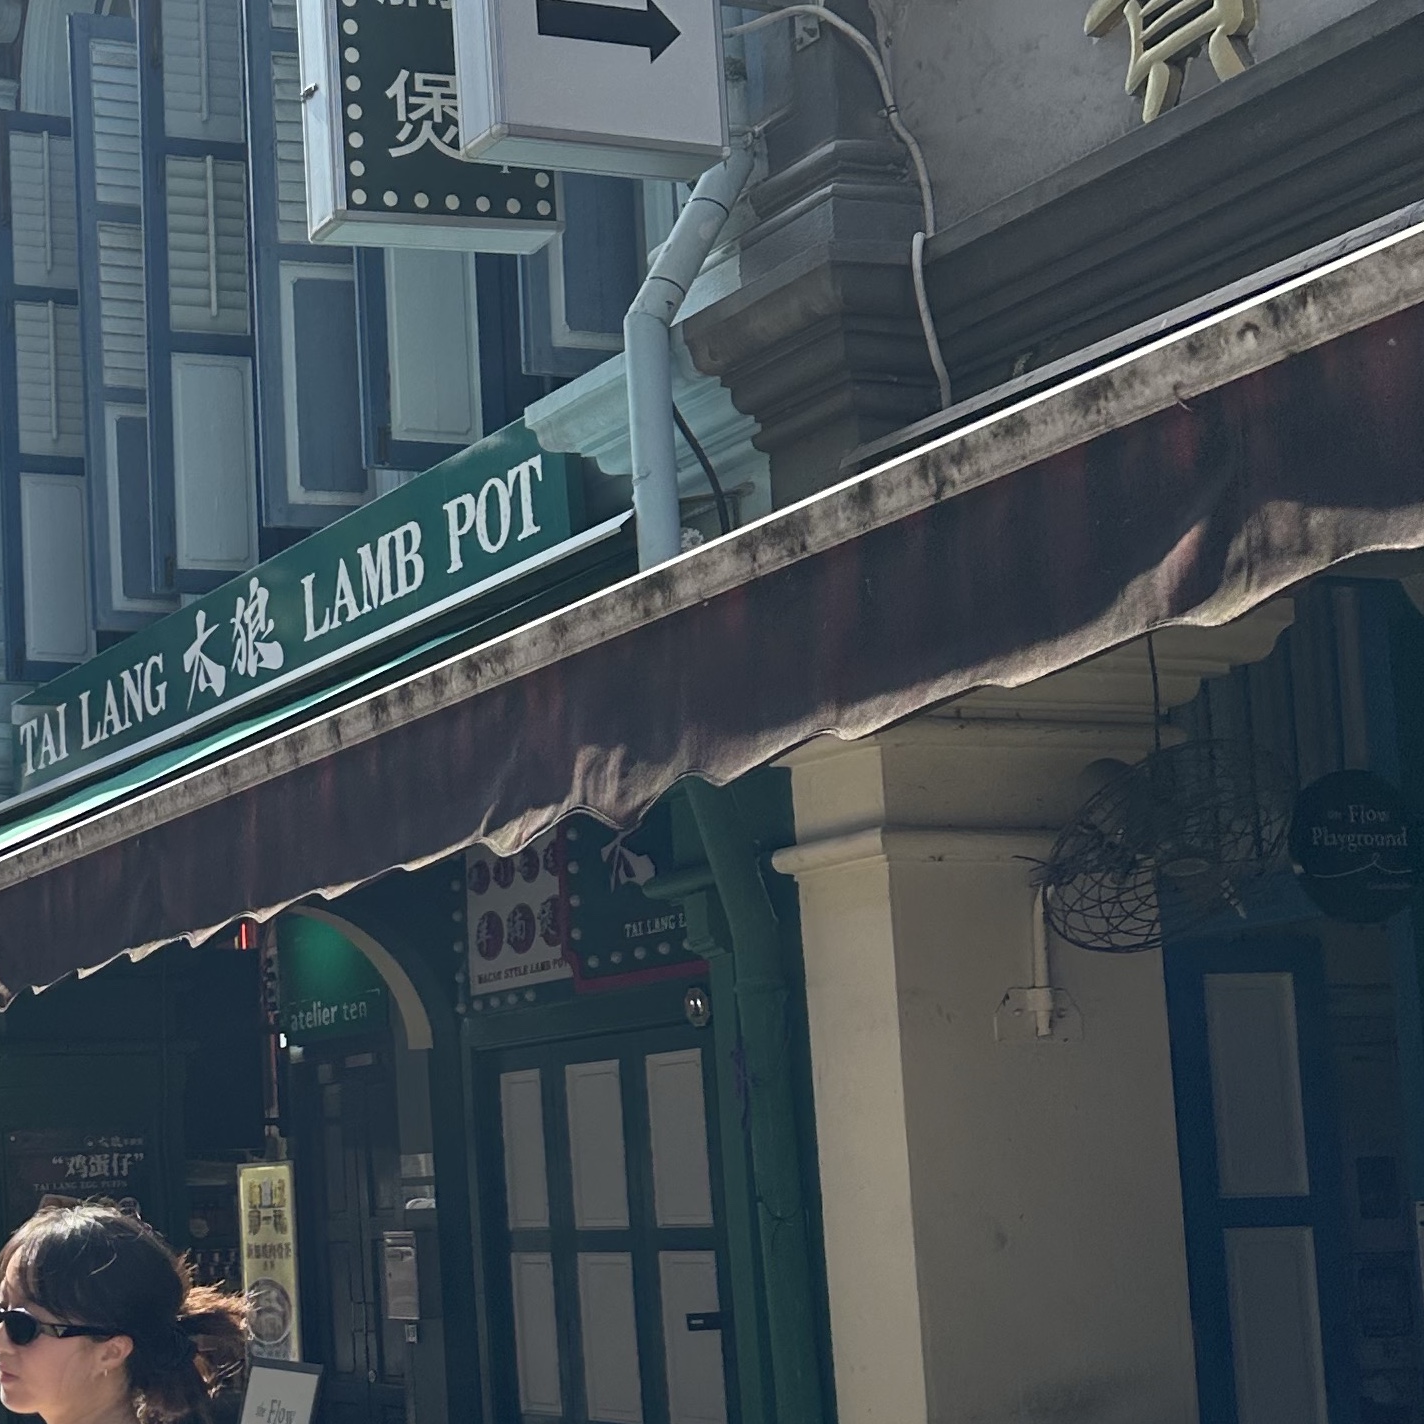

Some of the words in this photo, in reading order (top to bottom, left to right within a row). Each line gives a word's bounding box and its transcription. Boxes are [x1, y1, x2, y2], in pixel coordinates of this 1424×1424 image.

[300, 520, 426, 643] LAMB
[441, 454, 544, 574] POT
[19, 702, 70, 777] TAI
[79, 652, 170, 750] LANG
[1312, 825, 1408, 852] Playground
[624, 921, 644, 938] TAI
[647, 914, 676, 935] LANG
[290, 1001, 338, 1031] atelier
[342, 1001, 367, 1021] ten
